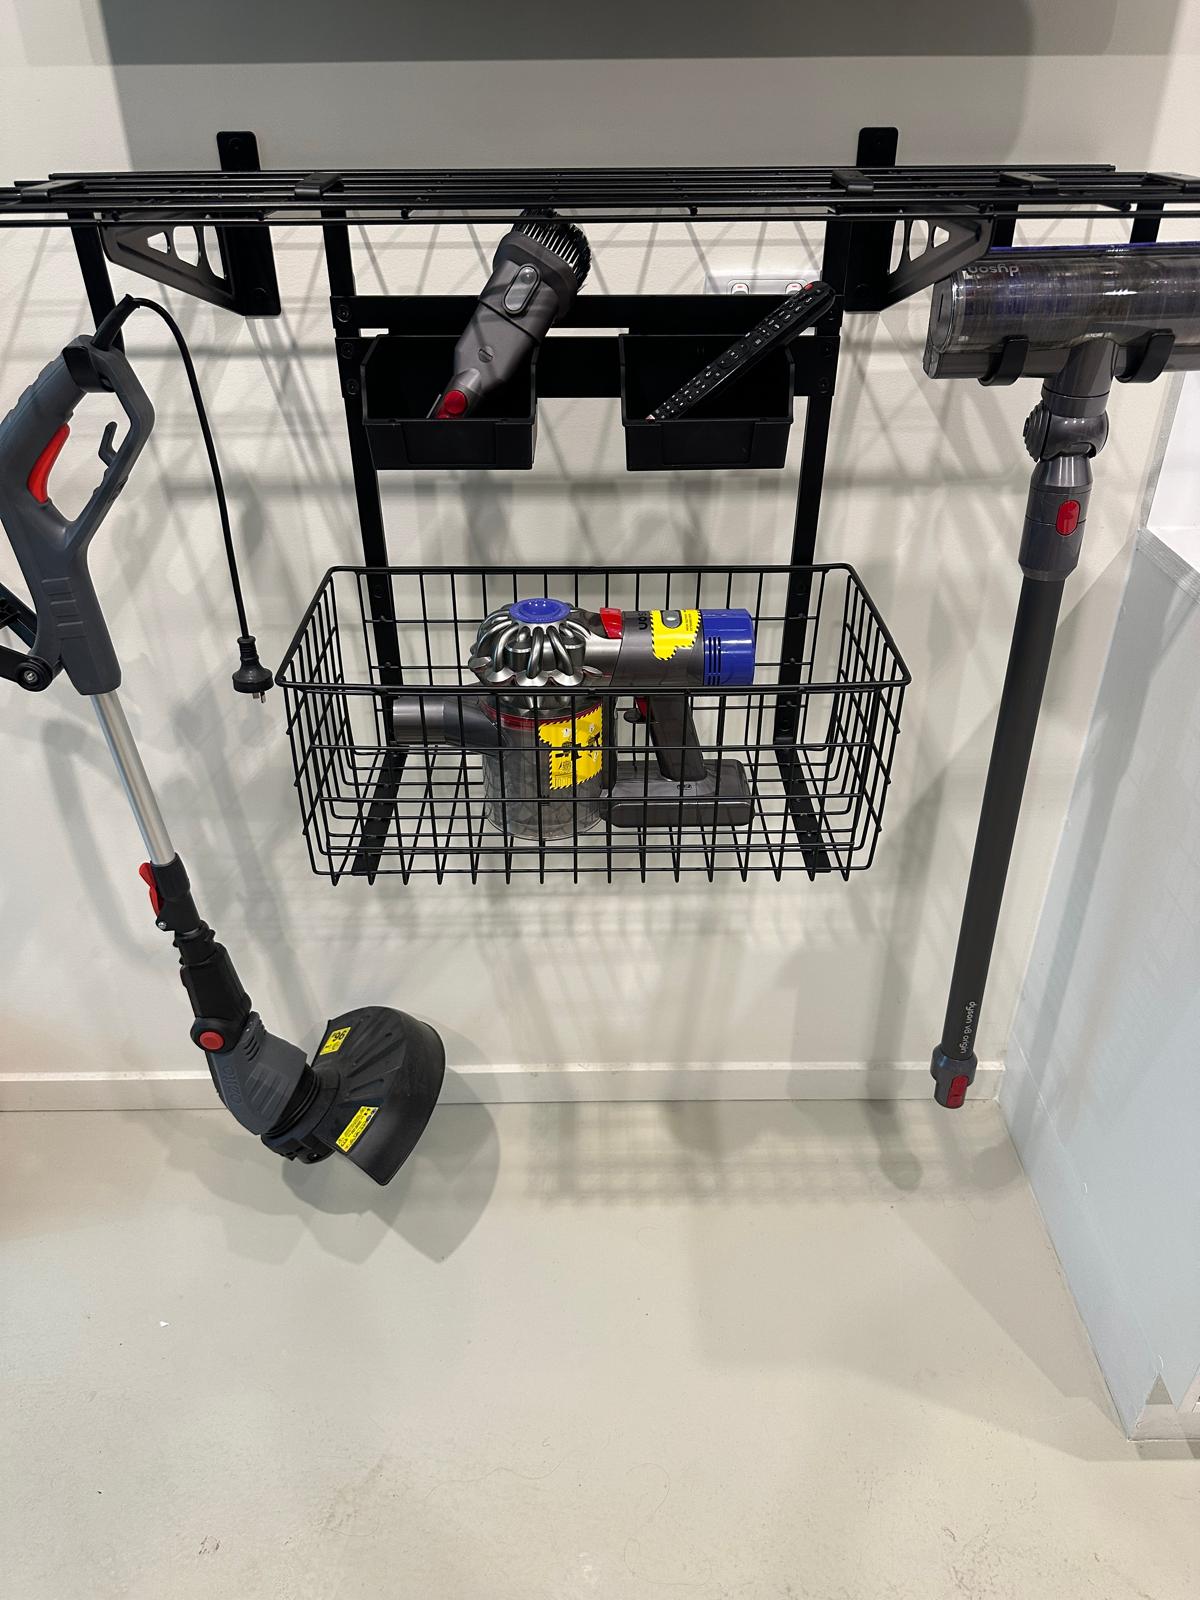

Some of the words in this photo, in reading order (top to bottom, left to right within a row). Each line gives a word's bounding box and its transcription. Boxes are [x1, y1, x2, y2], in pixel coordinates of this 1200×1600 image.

[967, 263, 1019, 277] dyson
[965, 1001, 977, 1023] dyson
[959, 1035, 970, 1054] origin
